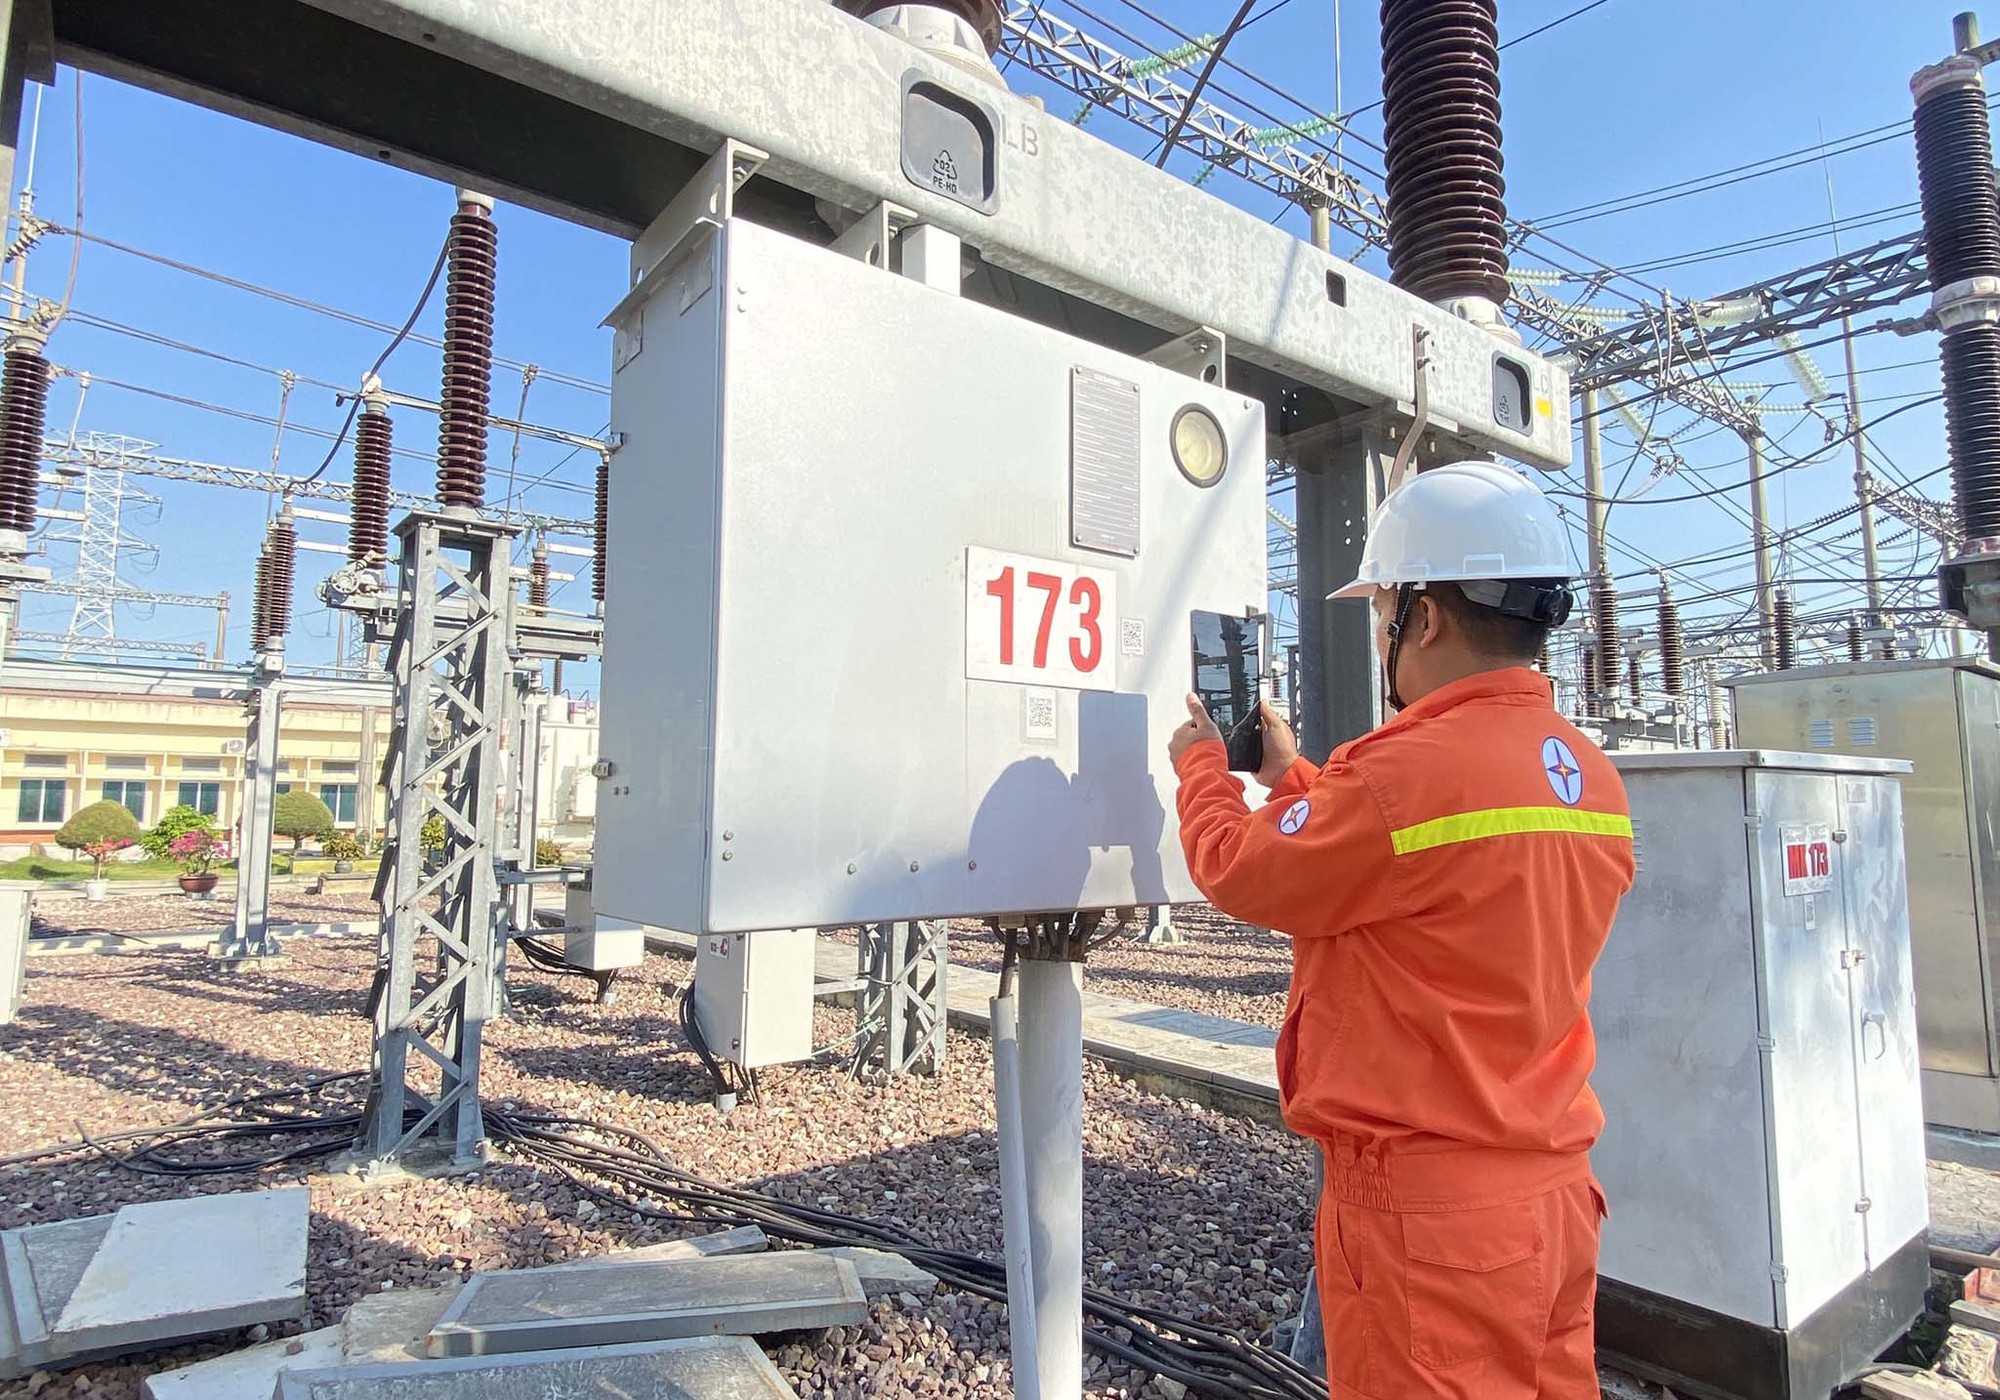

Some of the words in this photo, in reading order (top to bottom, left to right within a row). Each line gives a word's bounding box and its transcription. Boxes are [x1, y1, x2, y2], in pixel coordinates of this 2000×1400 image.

[1001, 114, 1038, 156] LB
[939, 160, 951, 172] 02
[986, 565, 1102, 673] 173
[1809, 842, 1828, 877] 173
